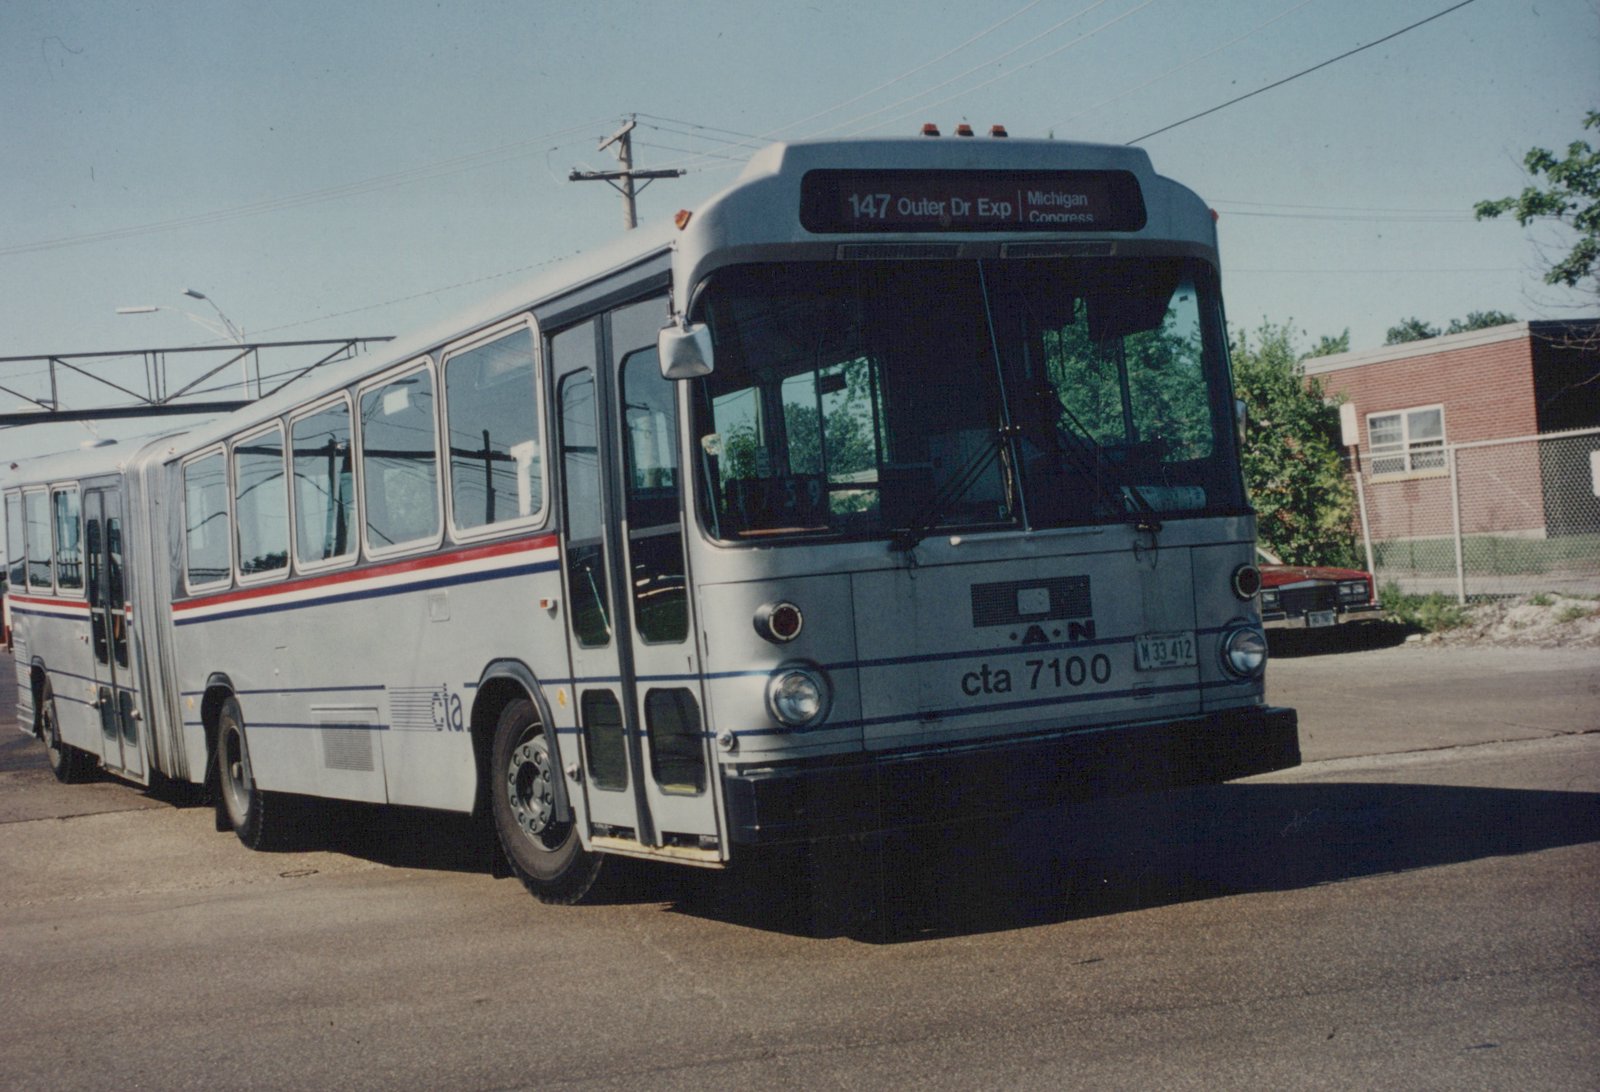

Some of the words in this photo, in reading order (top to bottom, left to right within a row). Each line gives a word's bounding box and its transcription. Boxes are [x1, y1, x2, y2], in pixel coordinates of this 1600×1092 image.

[848, 193, 892, 219] 147
[897, 198, 946, 217] Outer
[951, 198, 972, 217] Dr
[977, 198, 1012, 219] Exp
[1027, 191, 1089, 208] Michigan
[961, 663, 1013, 696] cta
[1025, 653, 1112, 690] 7100
[431, 682, 465, 733] cta
